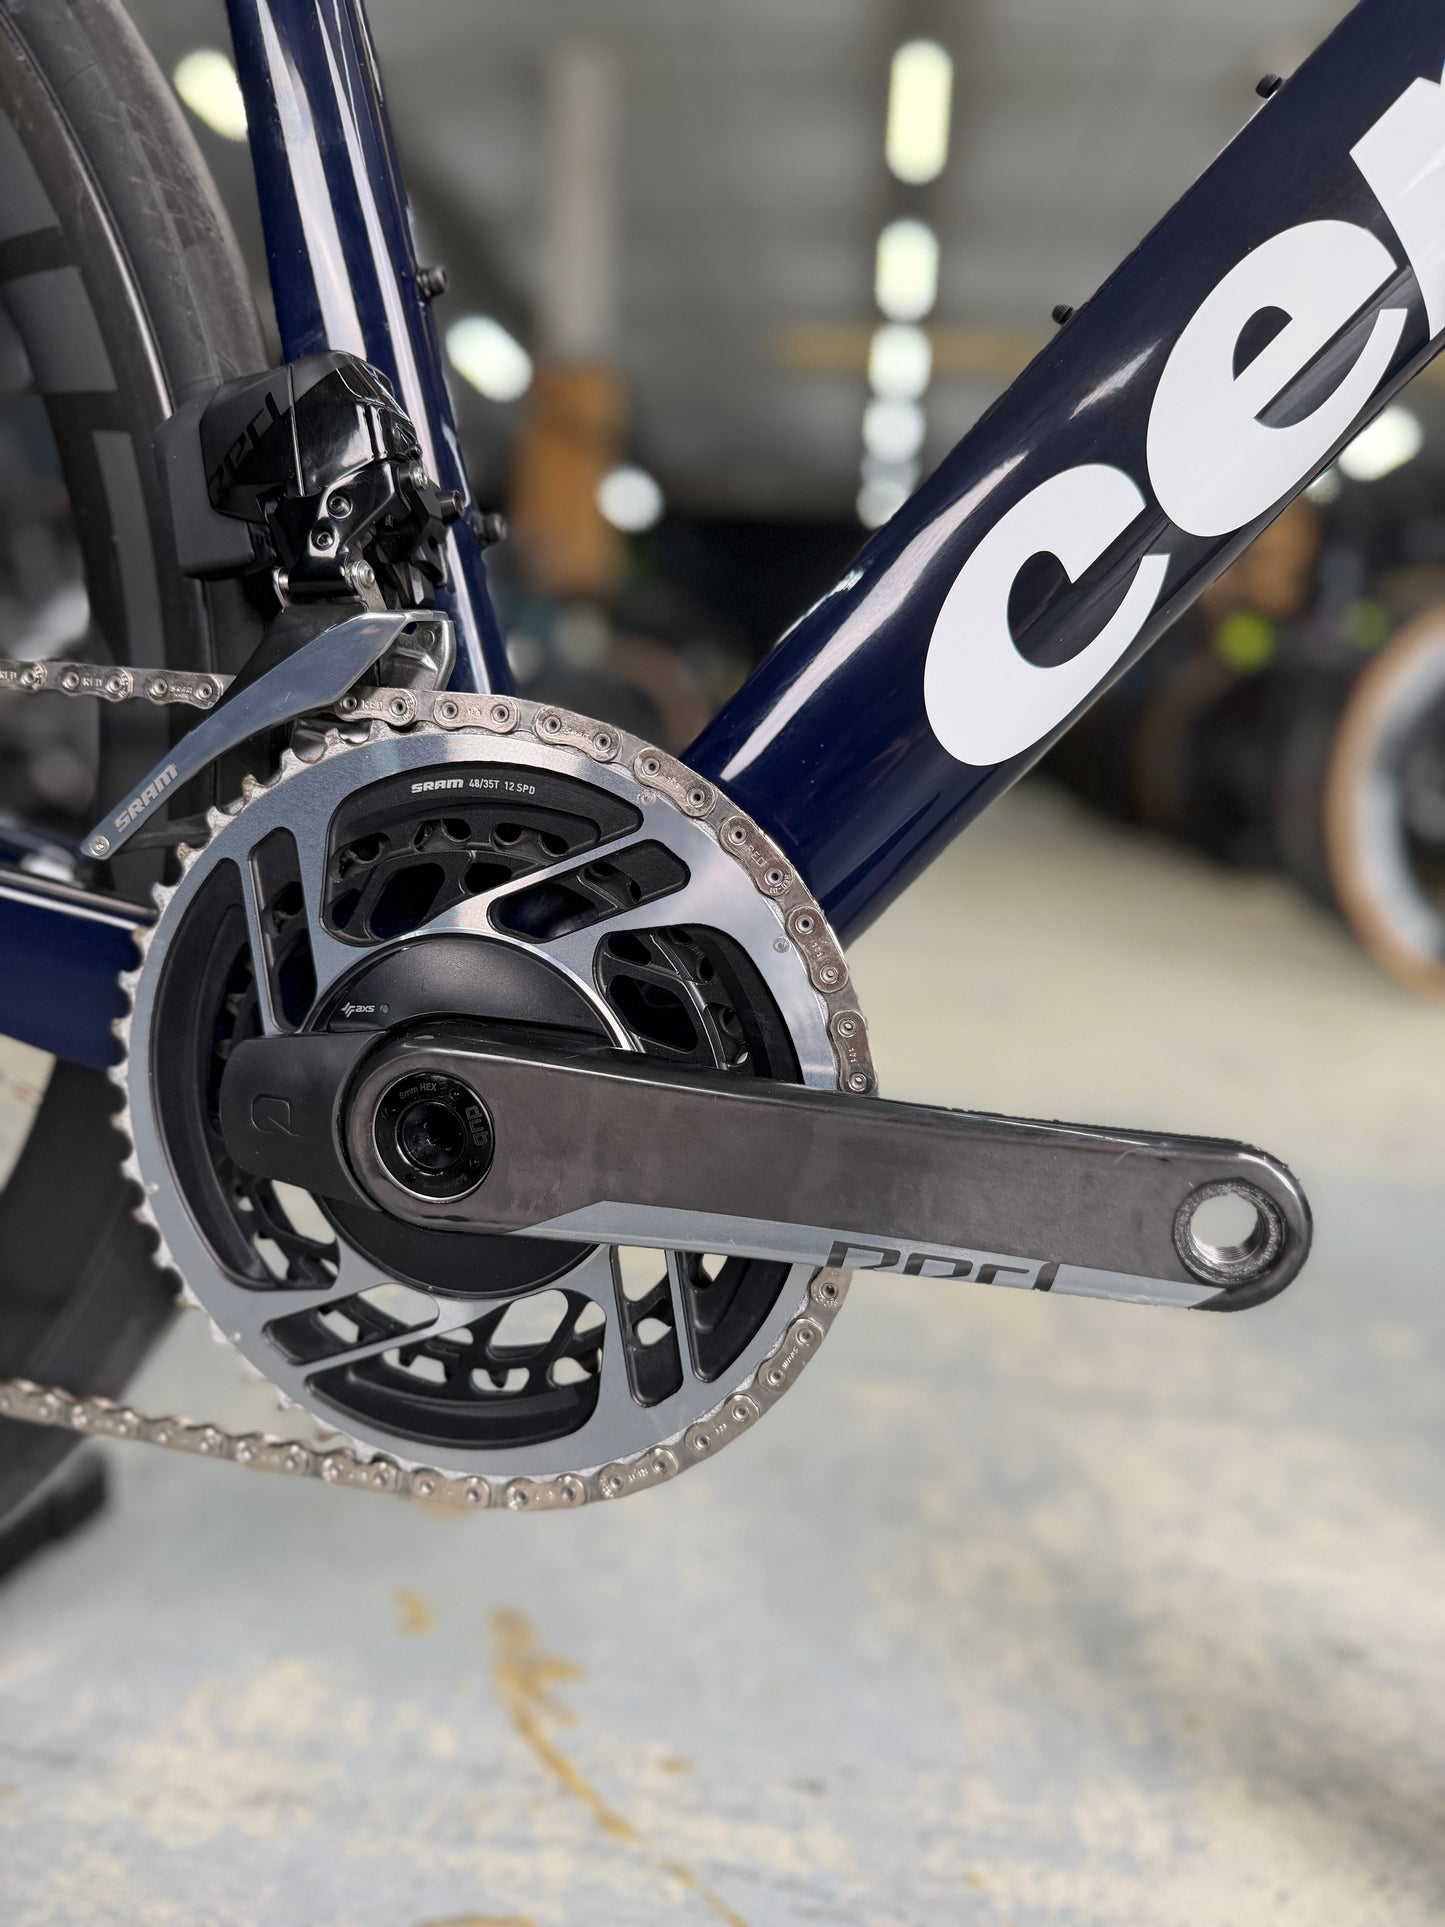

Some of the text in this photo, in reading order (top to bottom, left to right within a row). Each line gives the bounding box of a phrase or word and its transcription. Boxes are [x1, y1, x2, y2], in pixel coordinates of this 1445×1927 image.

[411, 778, 536, 795] SRAM 48/35T 12 SPD
[114, 763, 178, 832] SRAM
[399, 1082, 437, 1099] 8mm HEX
